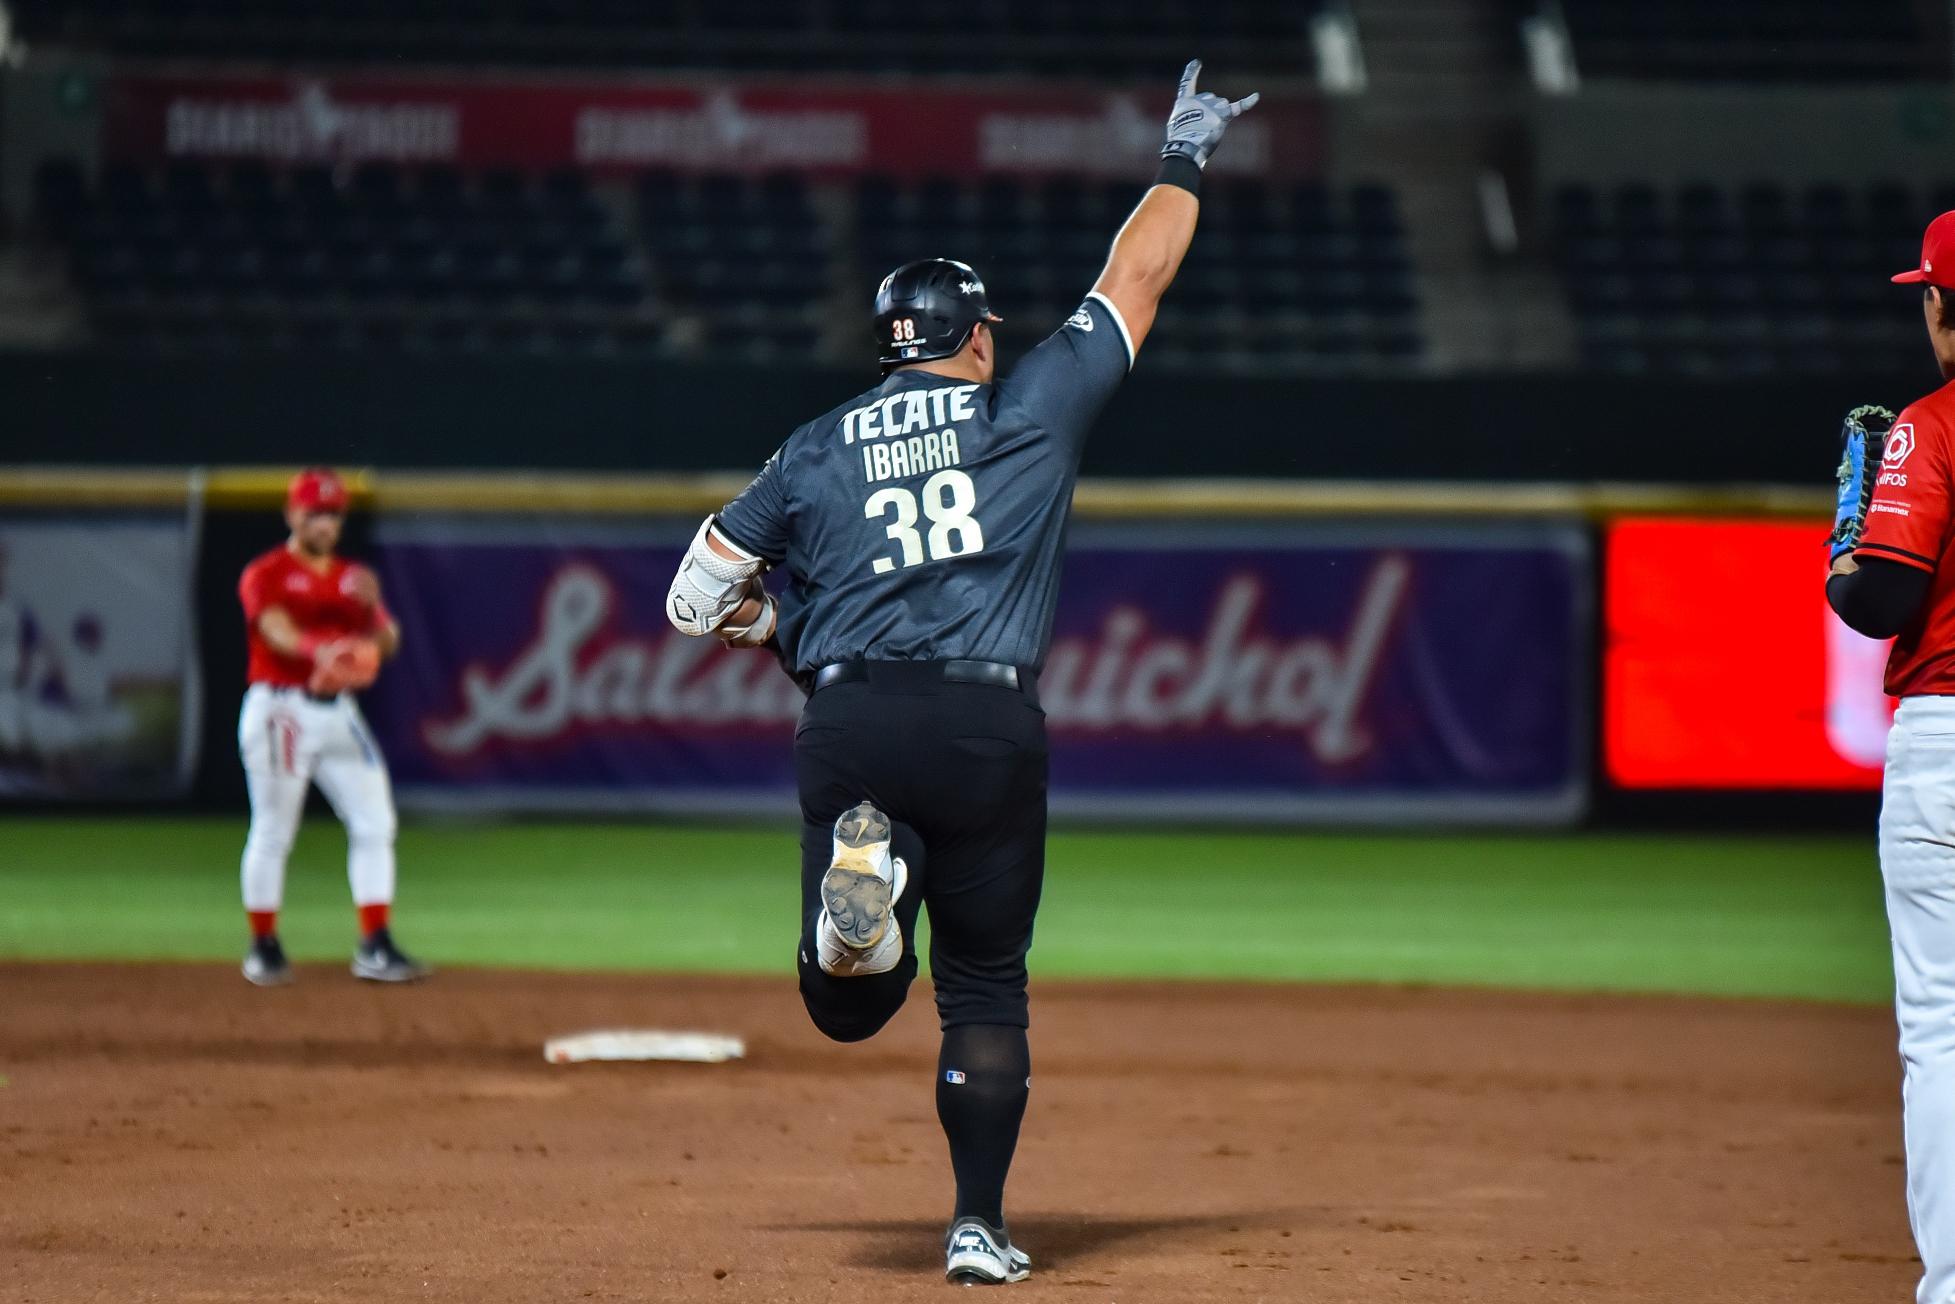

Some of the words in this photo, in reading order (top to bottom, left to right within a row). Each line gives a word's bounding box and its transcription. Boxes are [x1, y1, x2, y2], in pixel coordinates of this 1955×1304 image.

[892, 318, 915, 340] 38
[839, 384, 981, 445] TECATE
[862, 428, 961, 483] IBARRA
[864, 469, 984, 575] 38
[1877, 504, 1909, 516] Banamex
[1036, 557, 1409, 762] uichol
